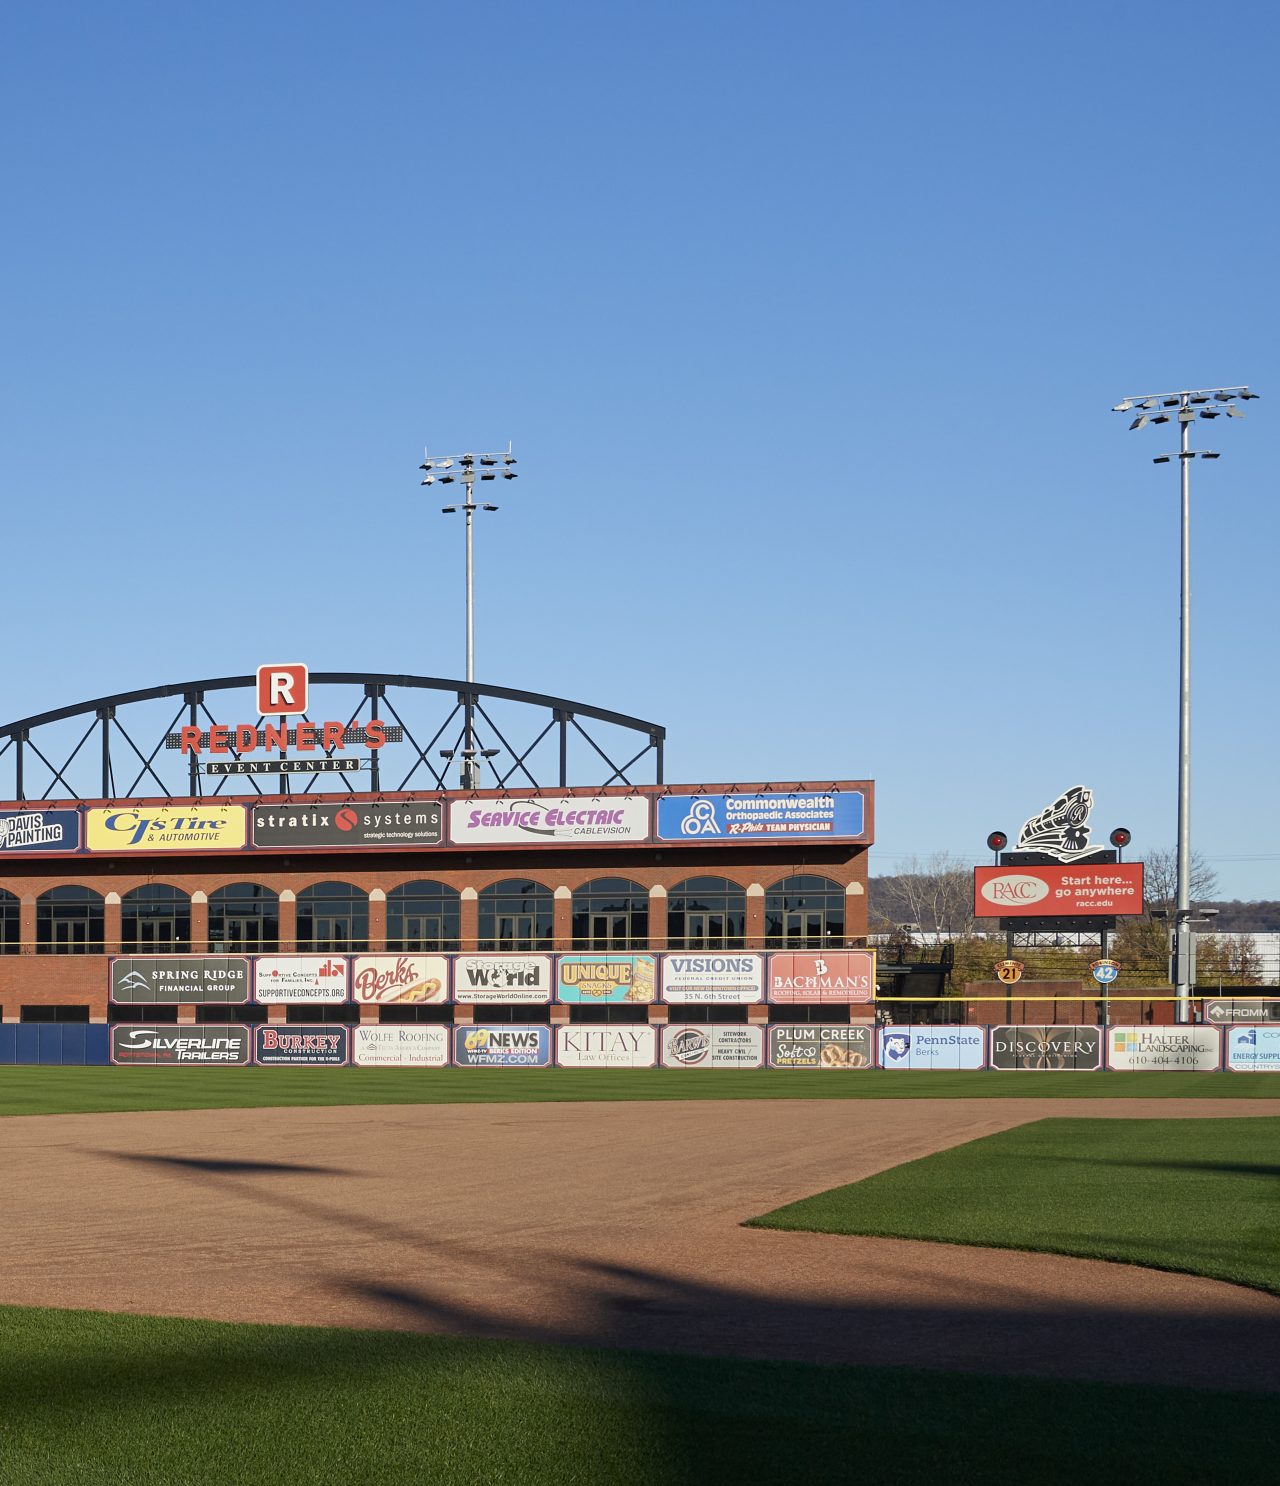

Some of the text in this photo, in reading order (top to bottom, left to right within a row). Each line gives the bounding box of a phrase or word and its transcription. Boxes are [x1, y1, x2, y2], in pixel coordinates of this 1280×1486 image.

[270, 672, 295, 705] R
[181, 720, 386, 755] REDNER'S
[211, 760, 355, 774] EVENT CENTER
[726, 797, 835, 811] Commonwealth
[256, 813, 438, 828] stratix systems
[467, 808, 625, 828] SERVICE ELECTRIC
[726, 810, 834, 821] Orthopaedic Associates
[8, 814, 42, 831] DAVIS
[729, 822, 831, 834] R-Phils TEAM PHYSICIAN
[105, 813, 227, 845] CJ's Tire
[386, 831, 414, 839] technology
[573, 827, 631, 835] CABLEVISION
[8, 825, 61, 846] PAINTING
[148, 832, 220, 842] & AUTOMOTIVE
[1061, 876, 1133, 885] Start here...
[993, 881, 1037, 904] RACC
[1055, 886, 1135, 898] go anywhere
[1076, 899, 1113, 907] racc.edu
[465, 959, 537, 974] Storage
[670, 959, 754, 973] VISIONS
[151, 970, 244, 981] SPRING RIDGE
[355, 957, 419, 1000] Berks
[563, 964, 631, 984] UNIQUE
[1003, 968, 1016, 980] 21
[1096, 967, 1114, 979] 42
[774, 976, 869, 988] BACHMAN'S
[258, 989, 345, 997] SUPPORTIVECONCEPTS.ORG
[1225, 1008, 1269, 1017] FROMM
[118, 1030, 242, 1049] SILVERLINE
[262, 1029, 341, 1049] BURKEY
[359, 1030, 444, 1041] WOLFE ROOFING
[465, 1028, 539, 1049] 69 NEWS
[777, 1029, 865, 1040] PLUM CREEK
[916, 1035, 980, 1045] PennState
[1142, 1033, 1190, 1044] HALTER
[562, 1032, 646, 1051] KITAY
[996, 1041, 1096, 1054] DISCOVERY
[1139, 1043, 1205, 1052] LANDSCAPING
[175, 1049, 240, 1060] TRAILERS
[777, 1043, 804, 1058] Soft
[916, 1048, 939, 1056] Berks
[1233, 1052, 1259, 1060] ENERGY
[359, 1053, 444, 1062] Commercial Industrial
[467, 1055, 539, 1063] WFMZ.COM
[1129, 1056, 1199, 1065] 610-404-4106
